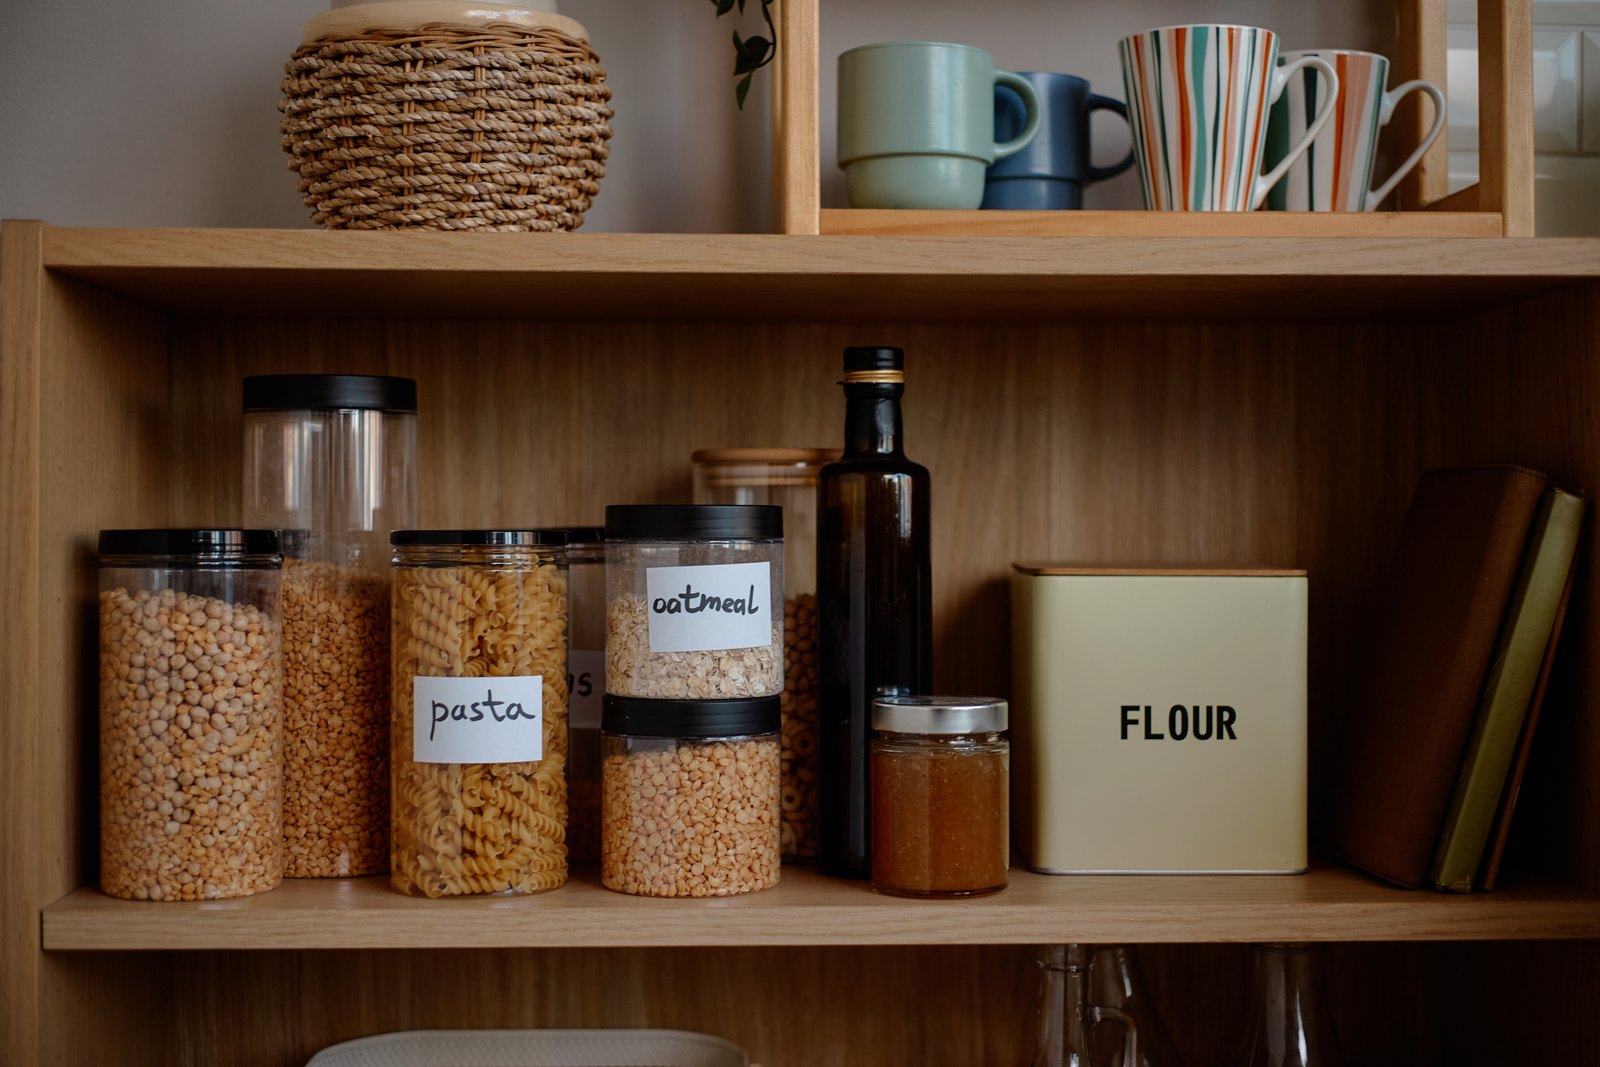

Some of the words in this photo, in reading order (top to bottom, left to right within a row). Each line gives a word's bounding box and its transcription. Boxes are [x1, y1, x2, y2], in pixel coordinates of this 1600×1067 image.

[652, 584, 759, 616] oatmeal
[429, 689, 536, 741] pasta
[1120, 704, 1238, 741] FLOUR
